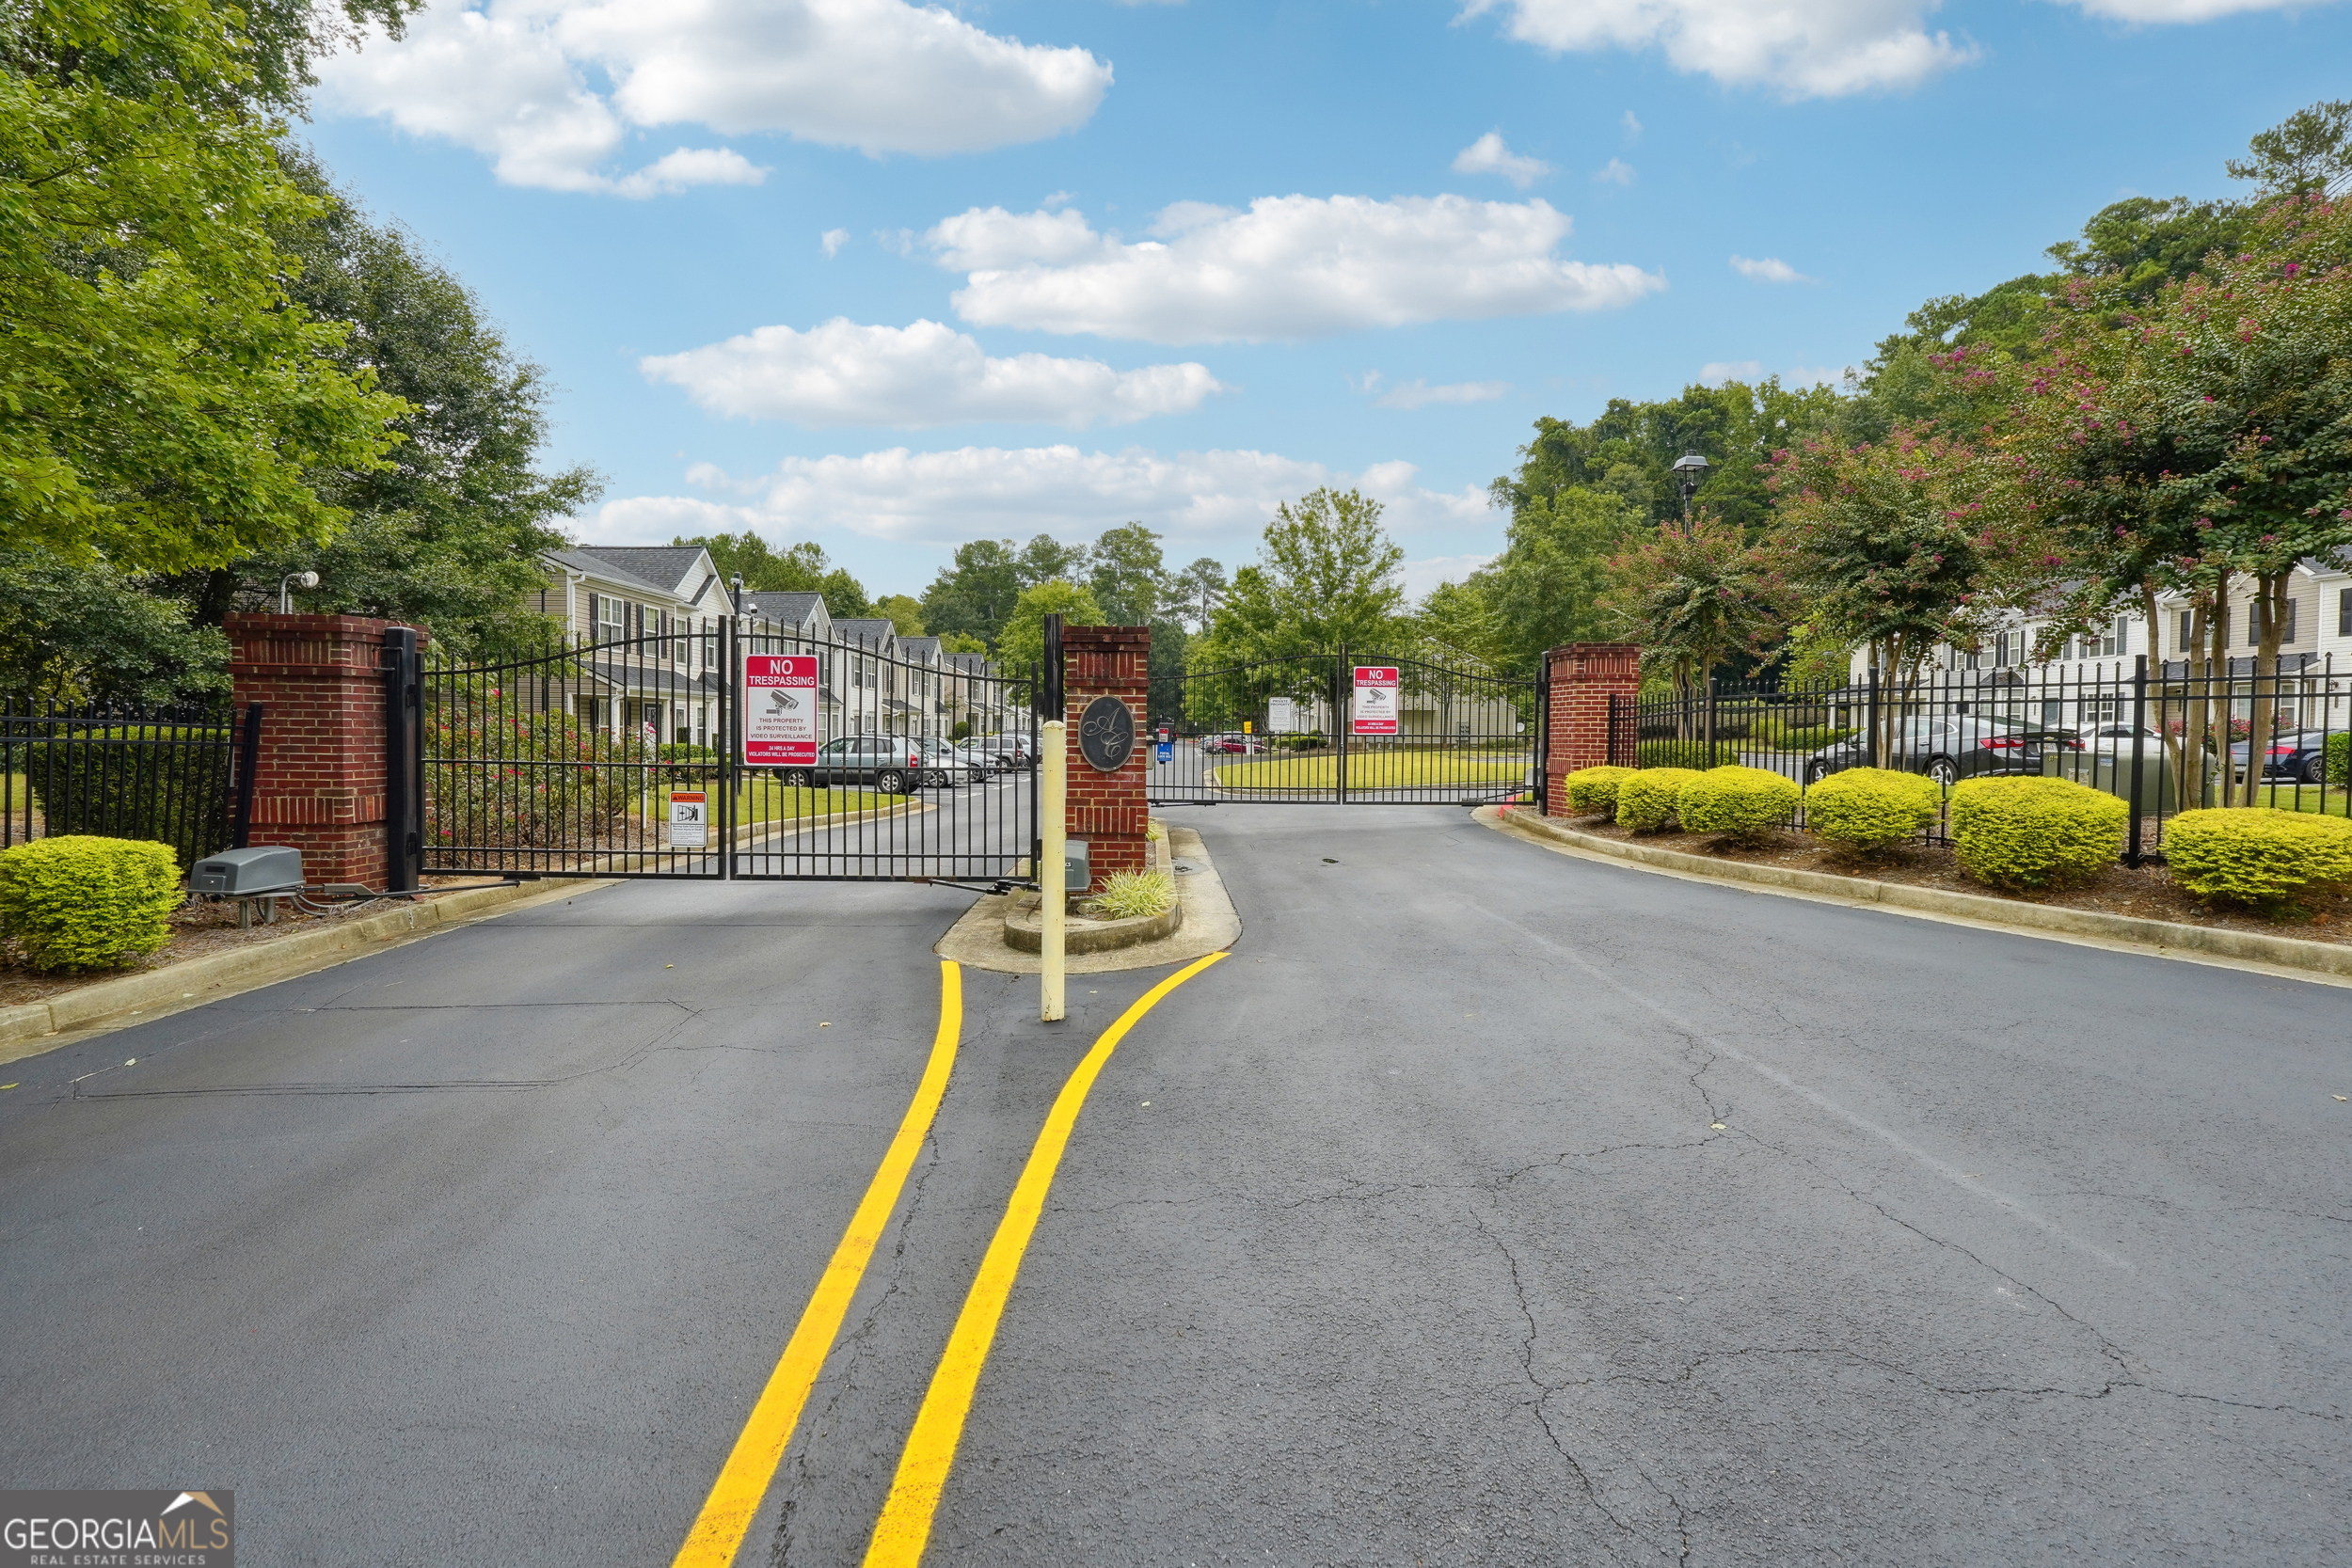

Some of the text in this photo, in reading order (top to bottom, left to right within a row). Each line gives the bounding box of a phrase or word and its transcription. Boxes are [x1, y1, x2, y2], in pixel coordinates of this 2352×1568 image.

[771, 659, 793, 674] NO
[1369, 670, 1383, 679] NO
[749, 675, 815, 686] TRESPASSING
